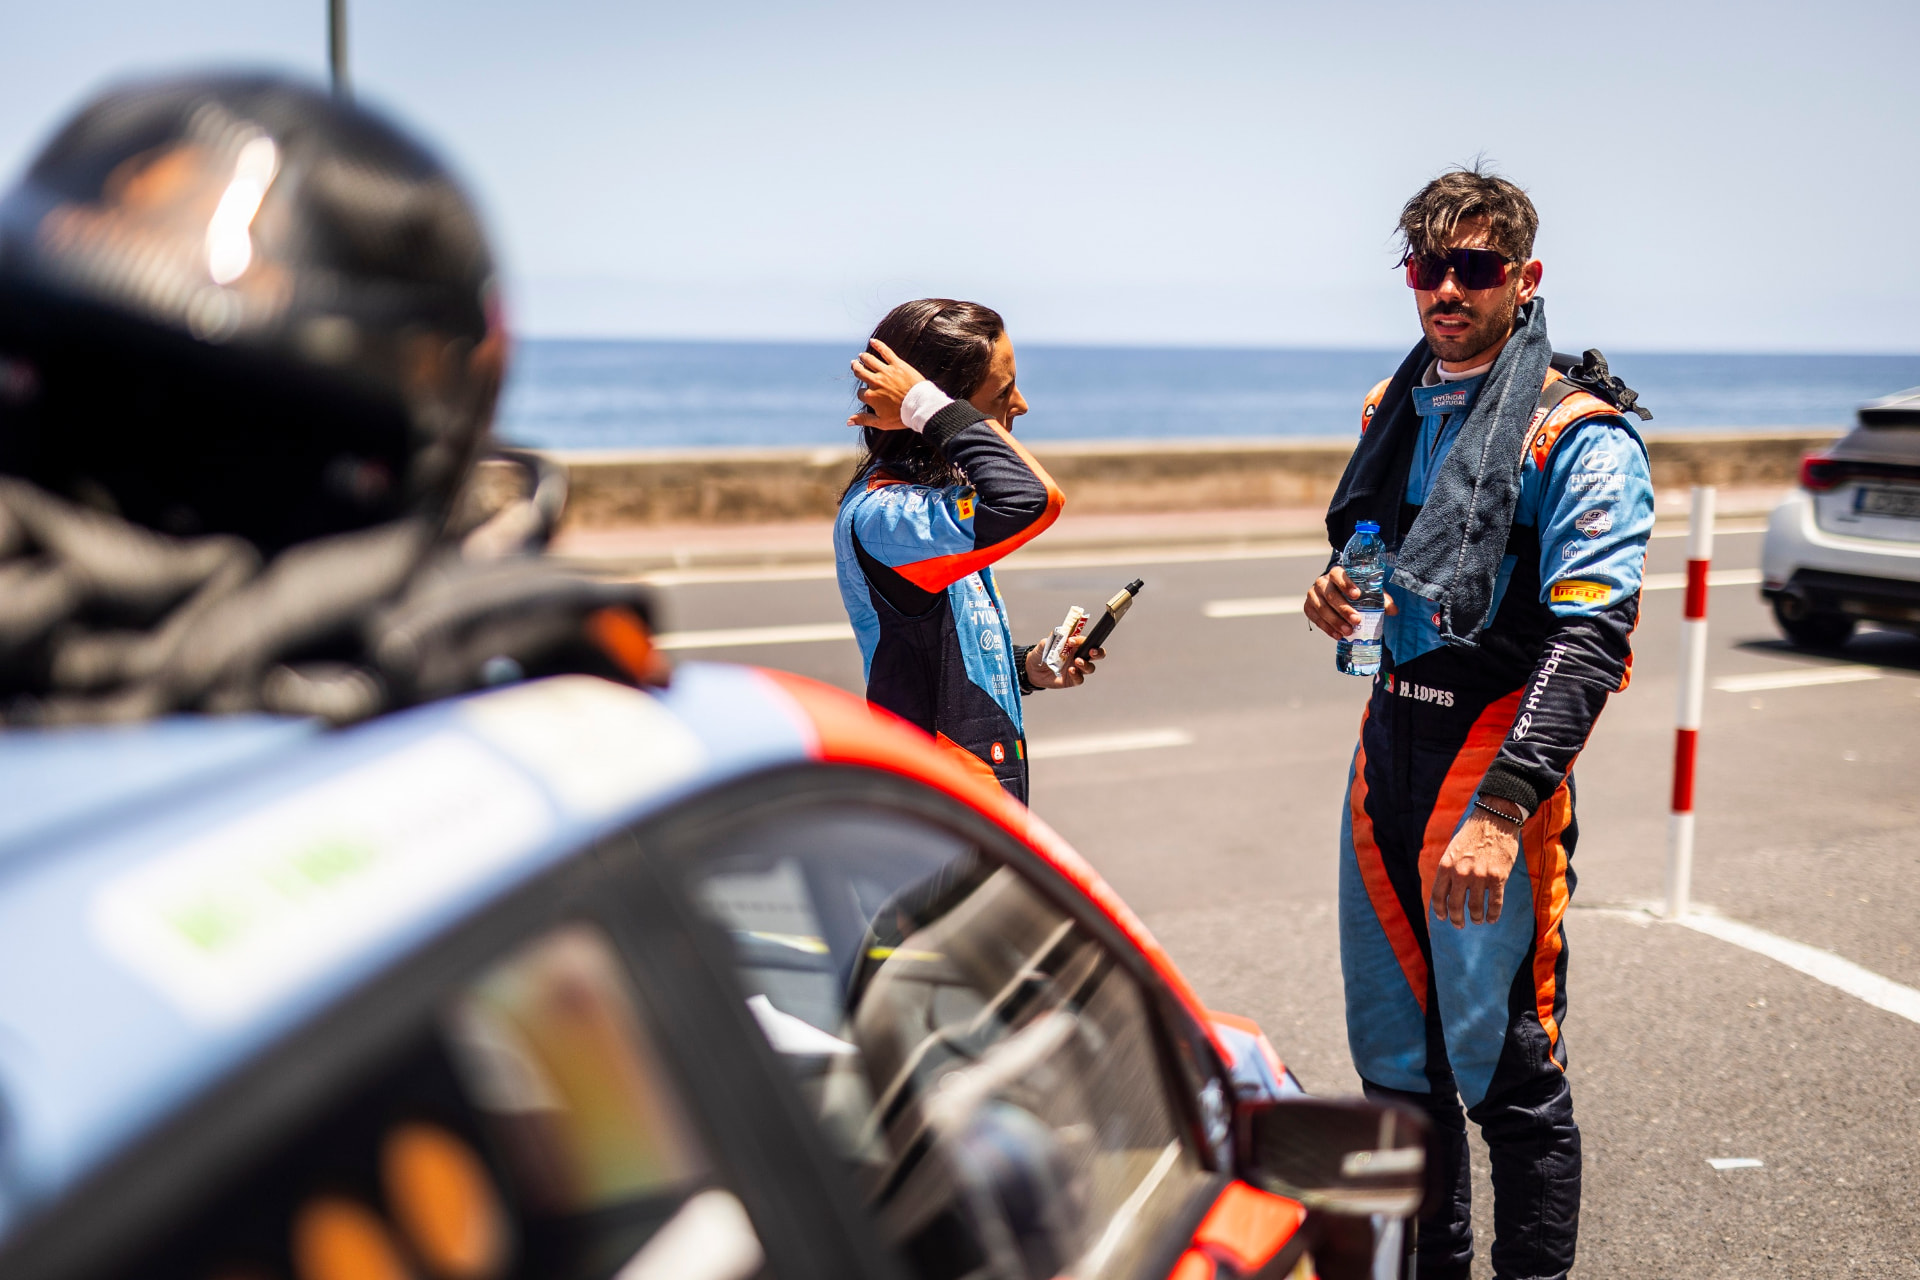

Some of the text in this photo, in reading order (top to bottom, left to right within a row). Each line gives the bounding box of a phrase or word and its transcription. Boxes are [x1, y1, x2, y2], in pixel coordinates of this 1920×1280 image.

[1432, 393, 1465, 403] HYUNDAI
[1570, 473, 1625, 484] HYUNDAI
[1554, 586, 1606, 600] PIRELLI
[1399, 680, 1455, 708] H. LOPES
